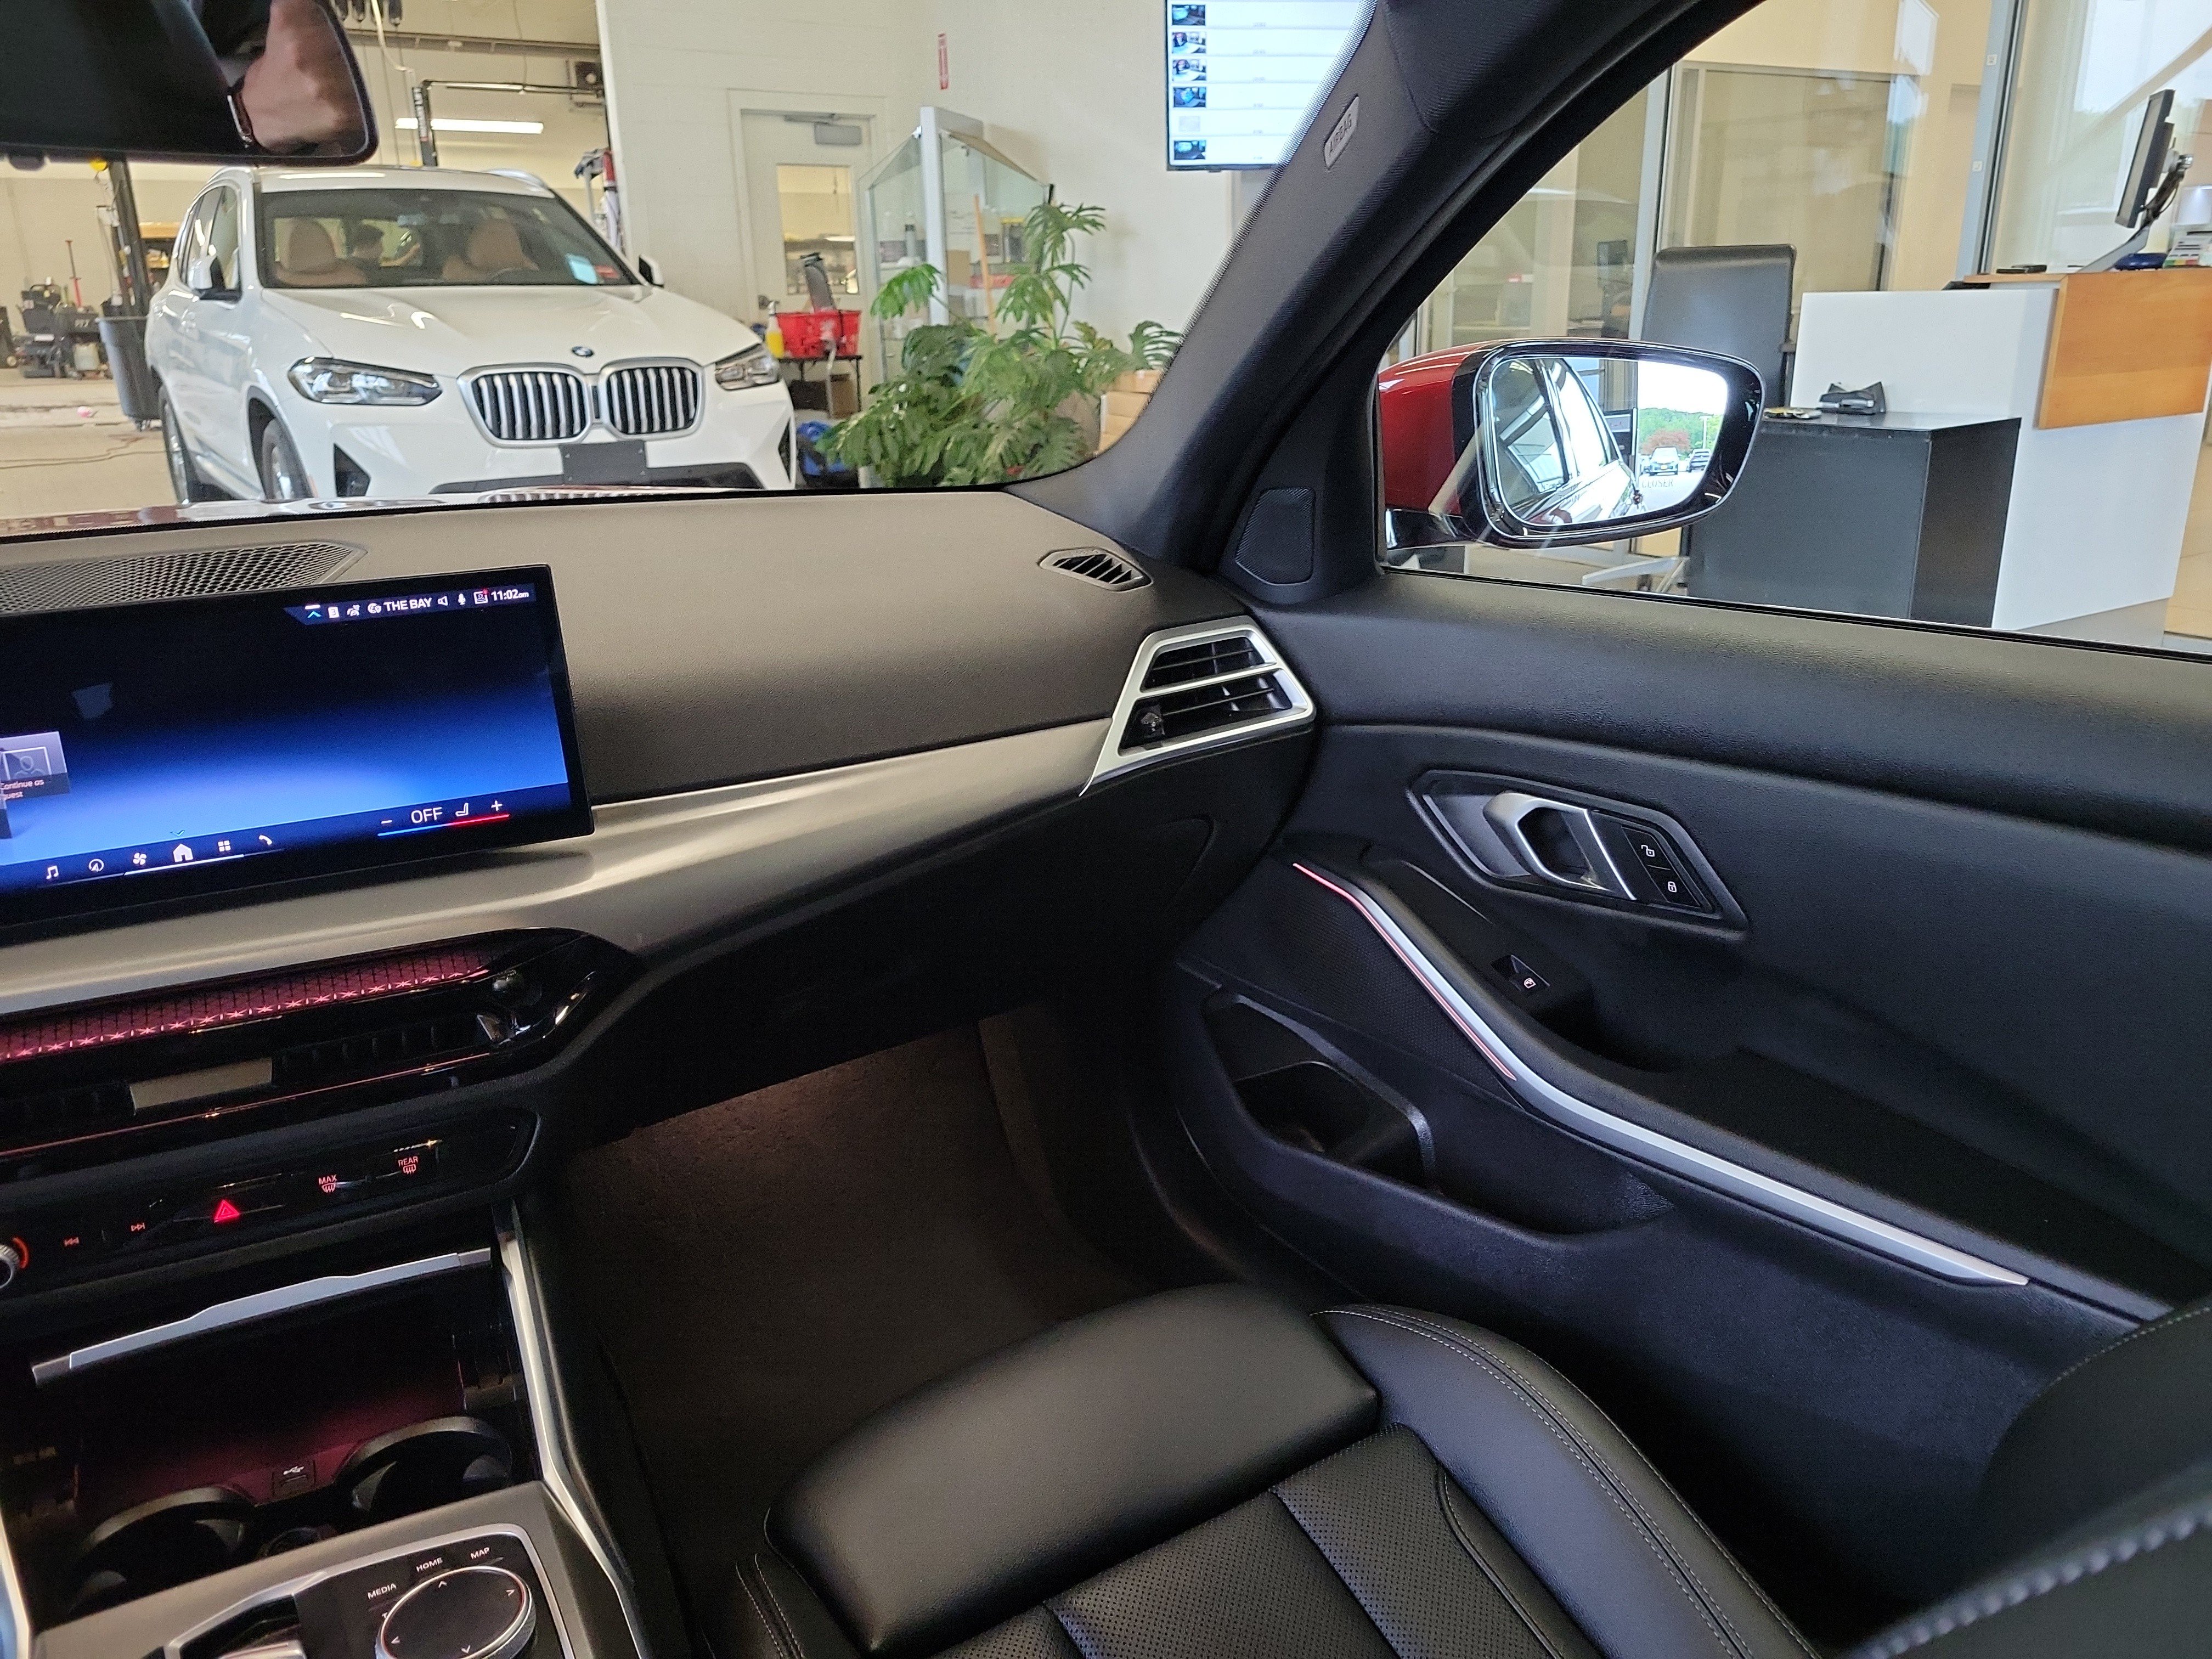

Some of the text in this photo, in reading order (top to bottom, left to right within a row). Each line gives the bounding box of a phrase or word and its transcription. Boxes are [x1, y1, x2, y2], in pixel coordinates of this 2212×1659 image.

[1328, 113, 1352, 158] AIRBAG
[1642, 478, 1673, 488] CLOSER
[491, 589, 529, 601] 11:02am
[383, 597, 432, 612] THE BAY
[411, 806, 443, 823] OFF
[398, 1156, 419, 1167] REAR
[318, 1174, 337, 1185] MAX
[470, 1547, 490, 1560] MAP
[416, 1558, 443, 1572] HOME
[367, 1583, 397, 1599] MEDIA
